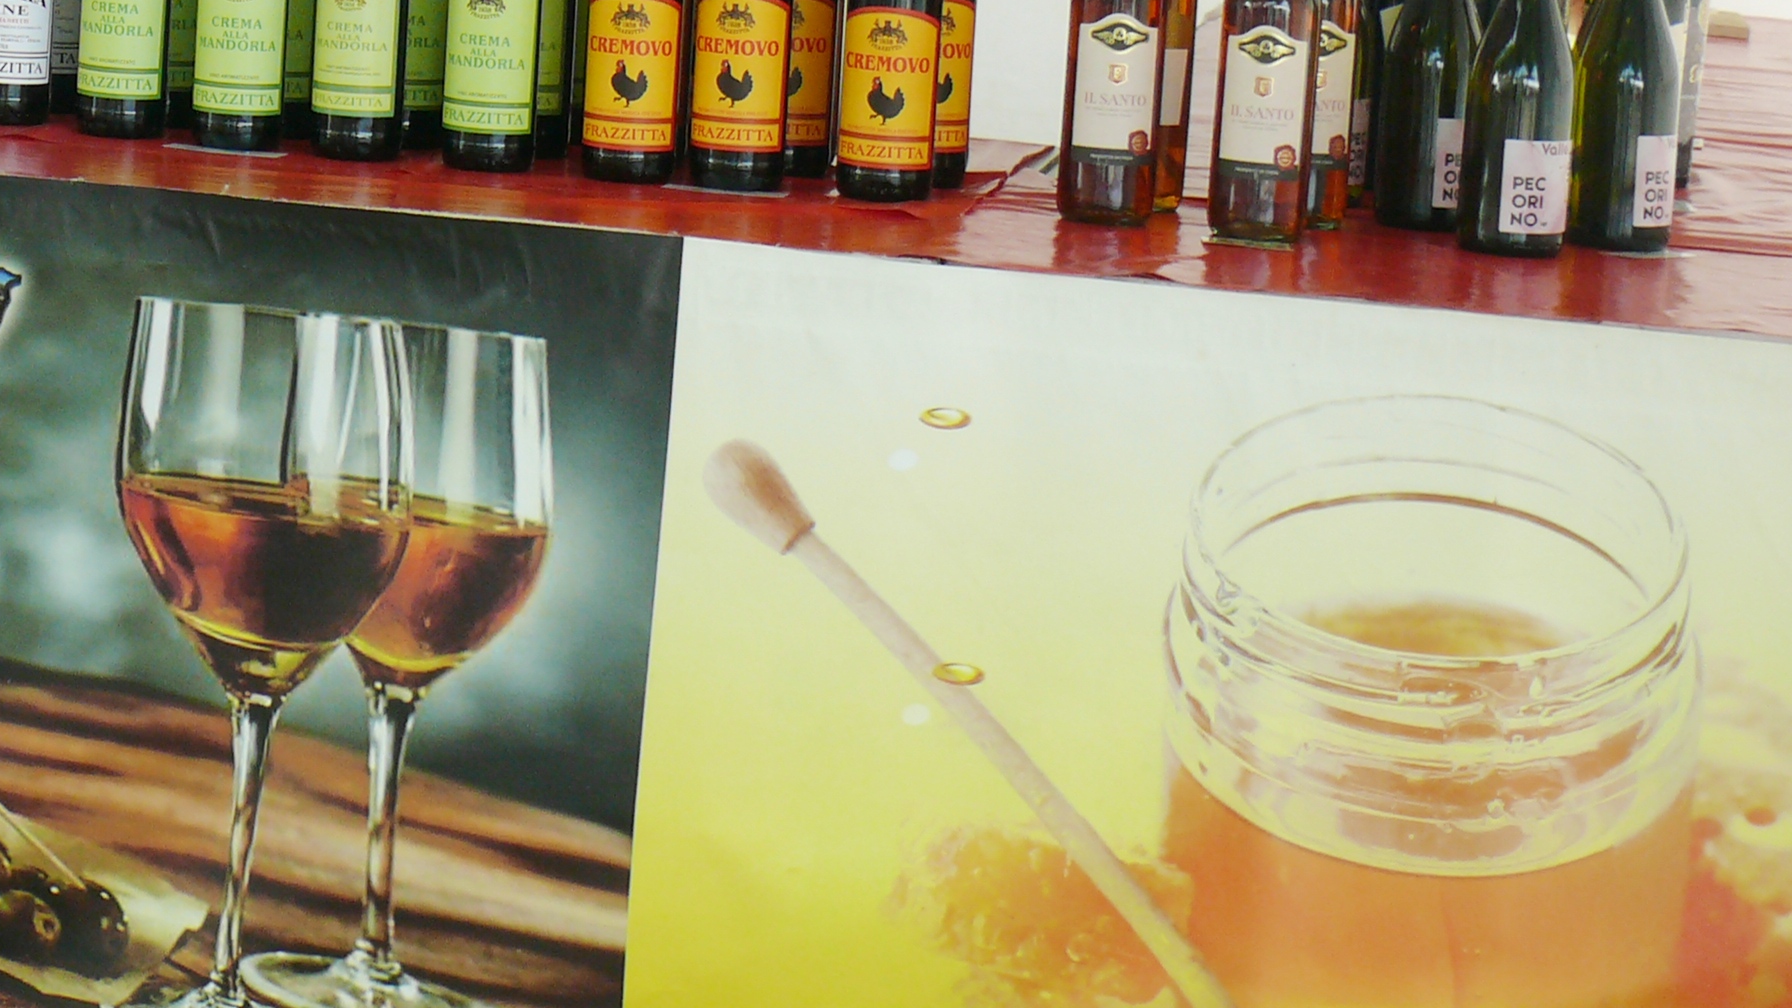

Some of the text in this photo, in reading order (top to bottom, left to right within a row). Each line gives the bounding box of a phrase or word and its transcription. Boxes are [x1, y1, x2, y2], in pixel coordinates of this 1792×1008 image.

[91, 1, 139, 14] CREMA
[100, 15, 125, 24] ALLA
[211, 16, 262, 30] CREMA
[327, 21, 373, 33] CREMA
[83, 21, 154, 37] MANDORLA
[222, 30, 249, 40] ALLA
[199, 36, 276, 52] MANDORLA
[459, 33, 510, 47] CREMA
[590, 35, 672, 57] CREMOVO
[697, 35, 779, 57] CREMOVO
[470, 48, 496, 57] ALLA
[448, 53, 525, 70] MANDORLA
[846, 52, 930, 74] CREMOVO
[78, 71, 153, 91] FRAZZITTA
[196, 88, 275, 107] FRAZZITTA
[1099, 93, 1147, 107] SANTO
[444, 107, 524, 126] FRAZZITTA
[1244, 105, 1294, 121] SANTO
[585, 123, 667, 141] FRAZZITTA
[693, 123, 774, 142] FRAZZITTA
[840, 141, 923, 160] FRAZZITTA
[1512, 176, 1547, 192] PEC
[1645, 171, 1670, 185] PEC
[1512, 194, 1544, 209] ORI
[1644, 188, 1668, 203] ORI
[1510, 213, 1538, 227] NO
[1643, 206, 1664, 220] NO
